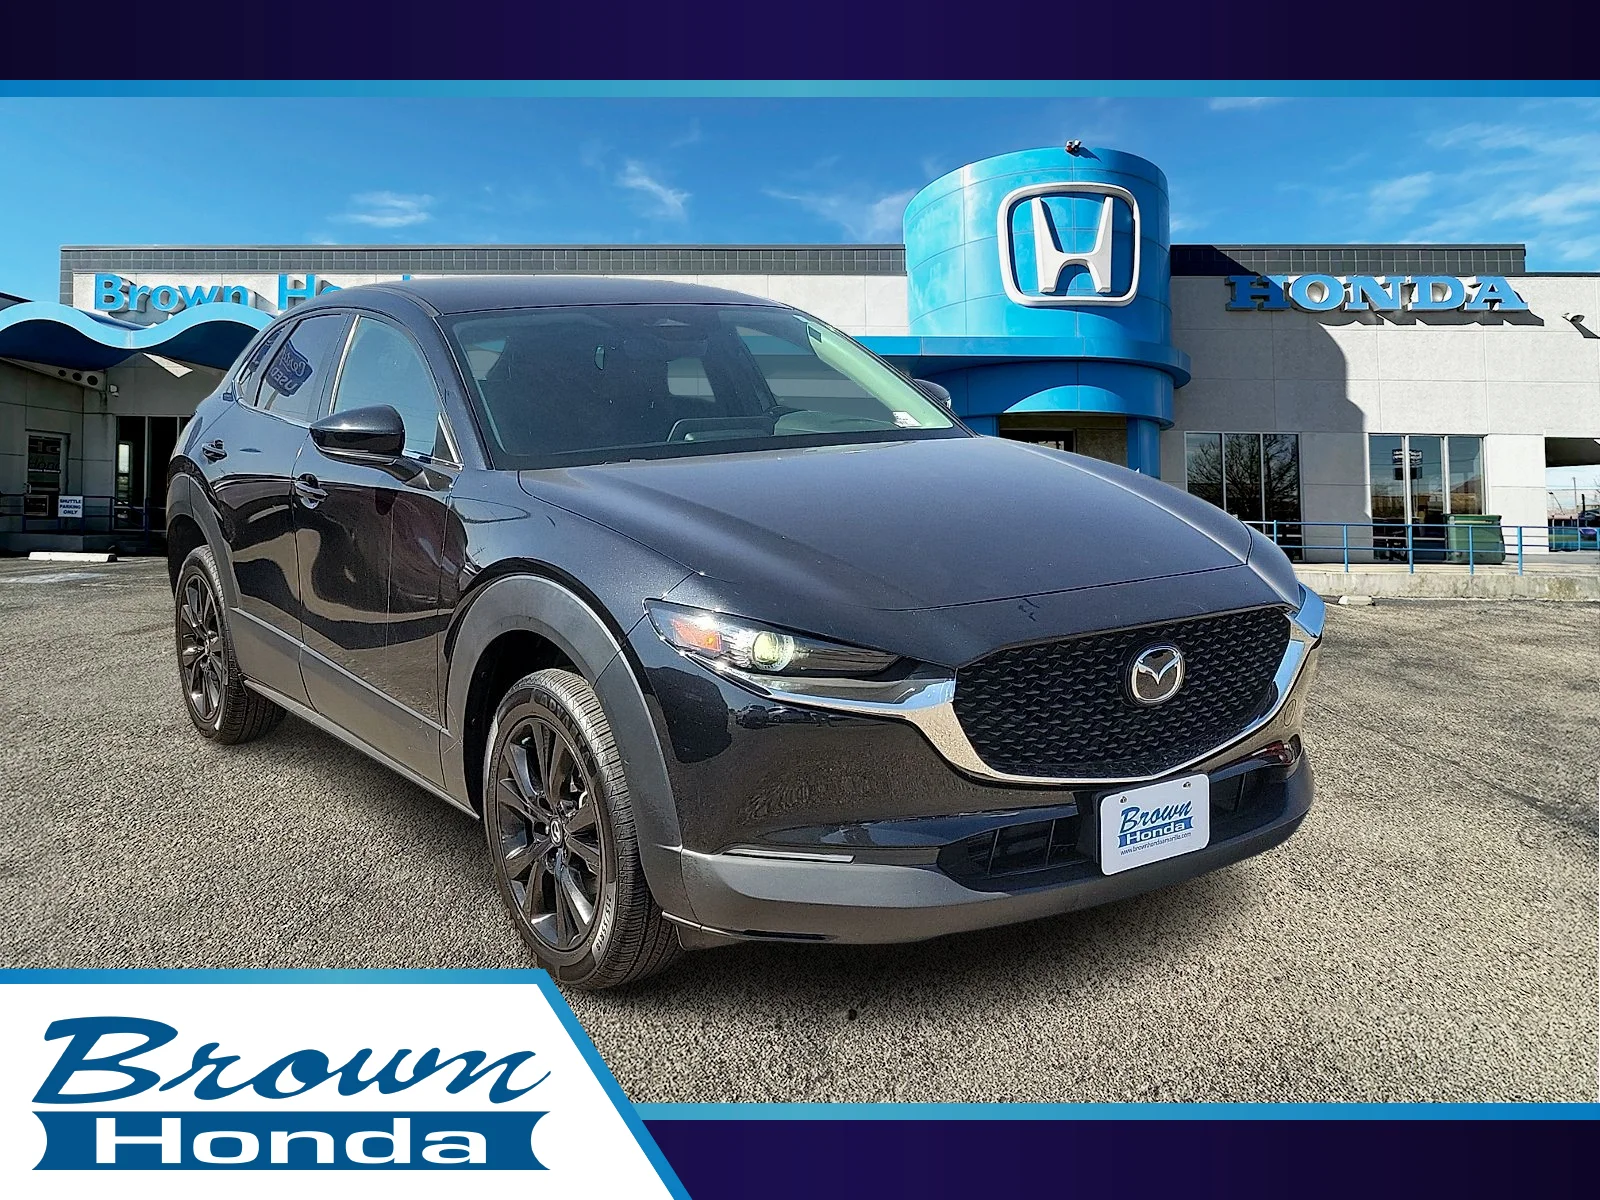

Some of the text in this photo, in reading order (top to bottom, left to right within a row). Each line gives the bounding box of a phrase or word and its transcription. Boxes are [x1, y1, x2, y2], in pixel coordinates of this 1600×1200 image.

[95, 273, 250, 312] Brown
[1225, 274, 1530, 312] HONDA
[1120, 800, 1193, 834] Brown
[1126, 821, 1186, 846] Honda
